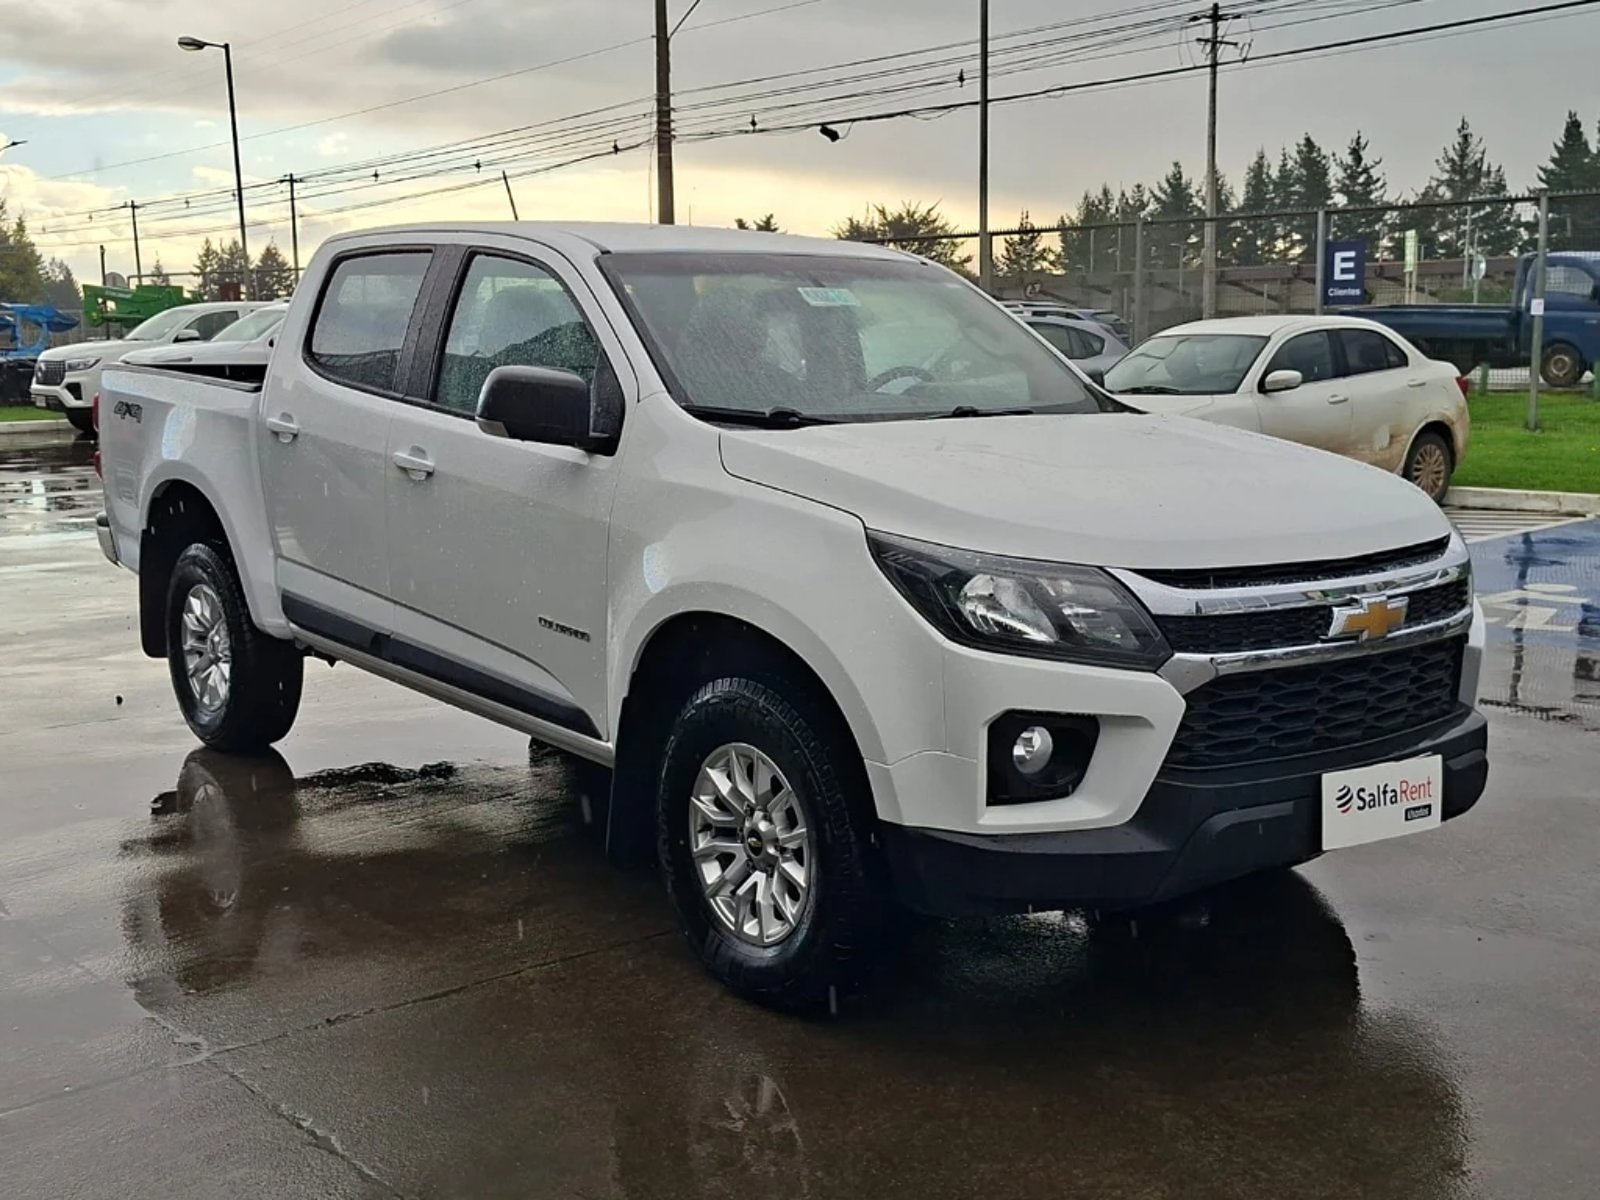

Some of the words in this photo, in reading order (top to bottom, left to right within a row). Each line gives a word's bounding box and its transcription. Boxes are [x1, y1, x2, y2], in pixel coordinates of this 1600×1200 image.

[1334, 251, 1356, 280] E
[1328, 287, 1361, 296] Clientes
[1356, 776, 1432, 811] SalfaRent
